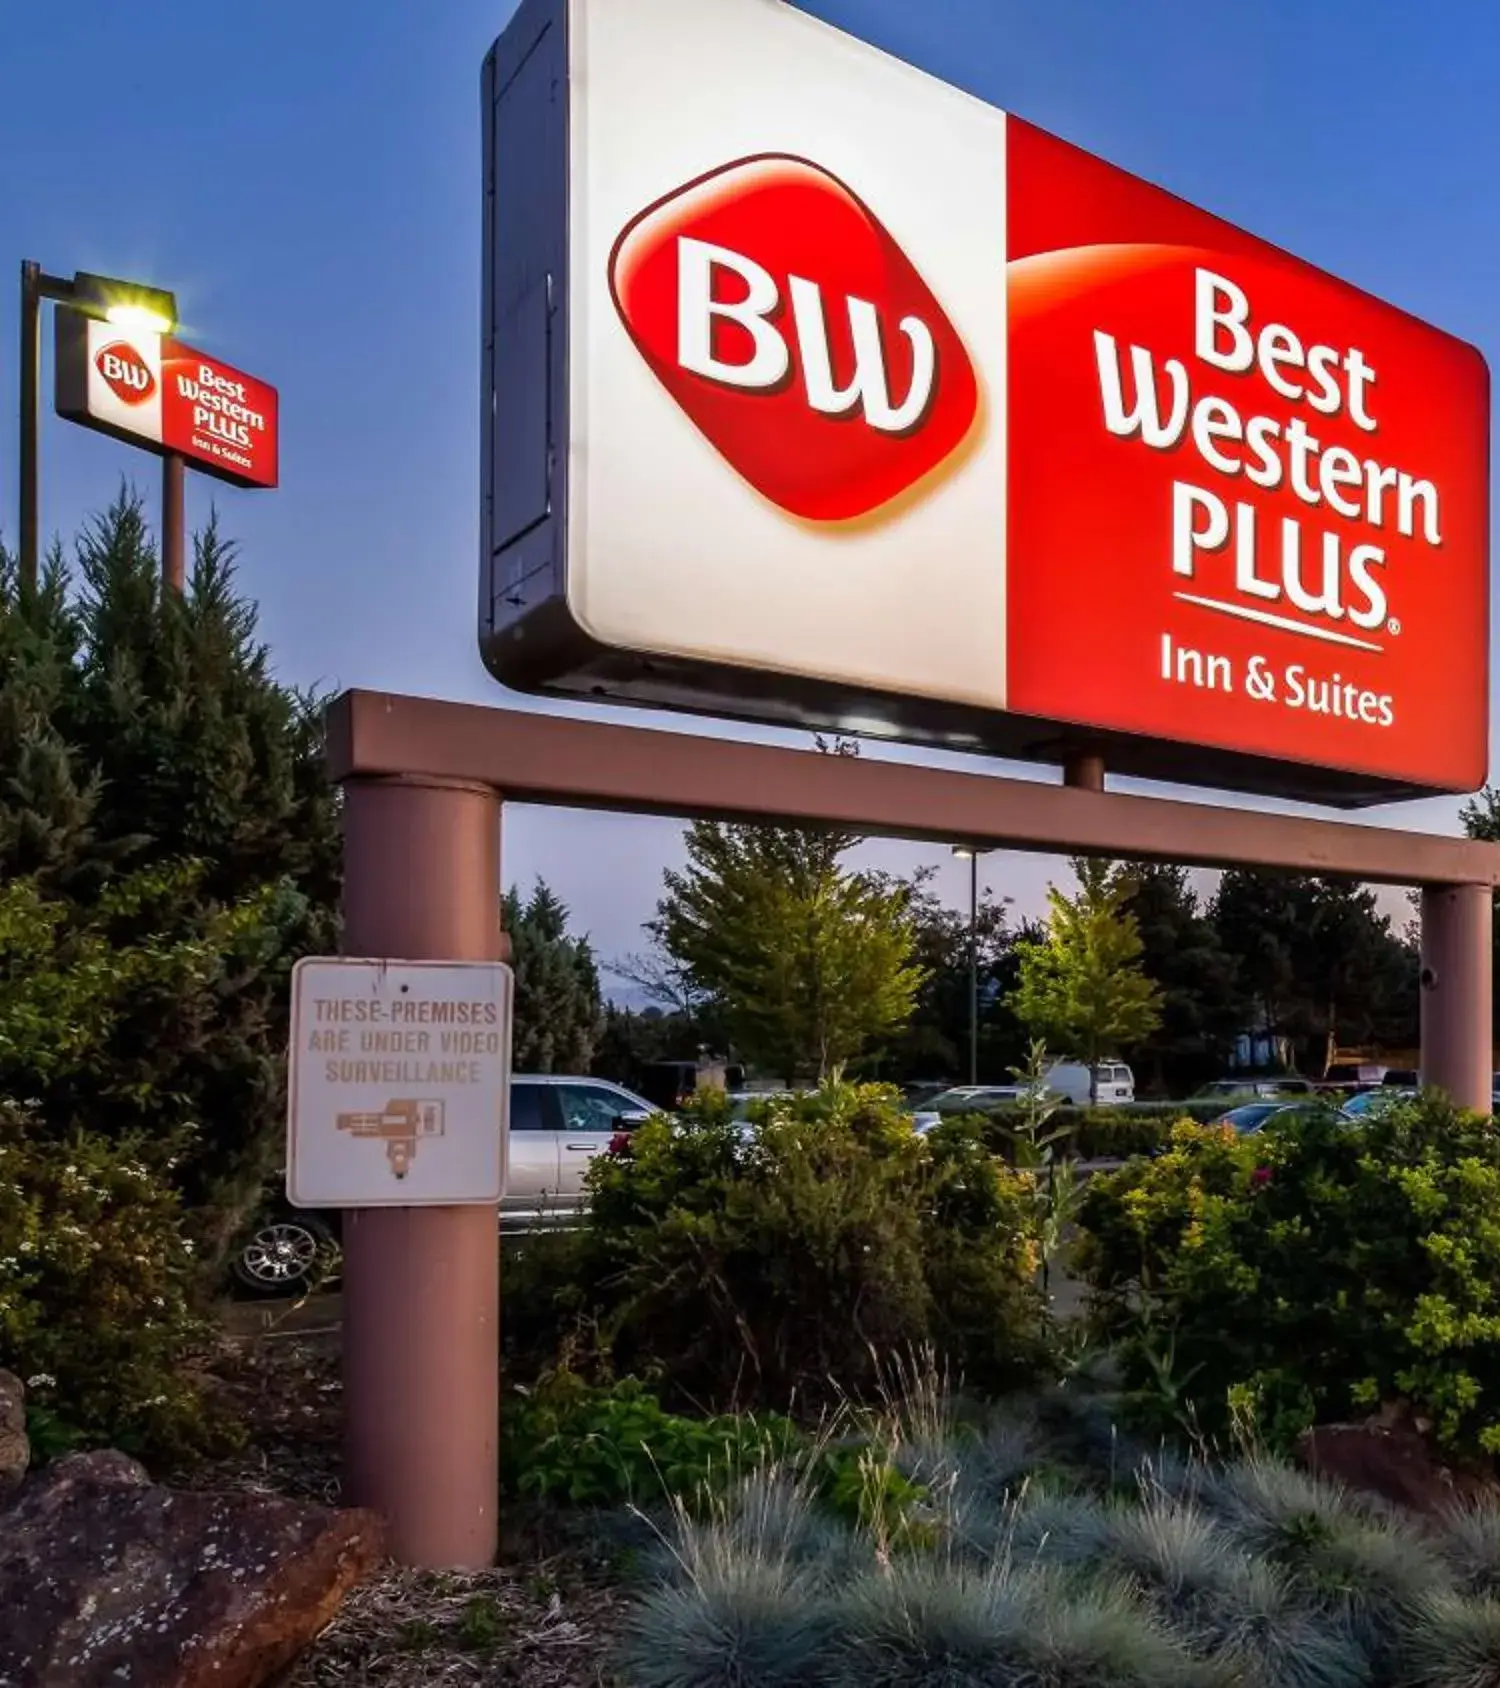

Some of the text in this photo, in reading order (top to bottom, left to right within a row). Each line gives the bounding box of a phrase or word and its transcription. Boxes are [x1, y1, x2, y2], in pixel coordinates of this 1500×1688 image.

[677, 235, 934, 431] BW
[1195, 267, 1377, 431] Best
[102, 353, 149, 391] BW
[199, 365, 247, 402] Best
[177, 374, 264, 430] Western
[193, 406, 249, 446] PLUS
[1093, 328, 1442, 545] Western
[1161, 633, 1394, 727] Inn & Suites
[314, 1000, 497, 1024] THESE PREMISES
[308, 1030, 499, 1055] ARE UNDER VIDEO
[325, 1060, 482, 1084] SURVEILLANCE
